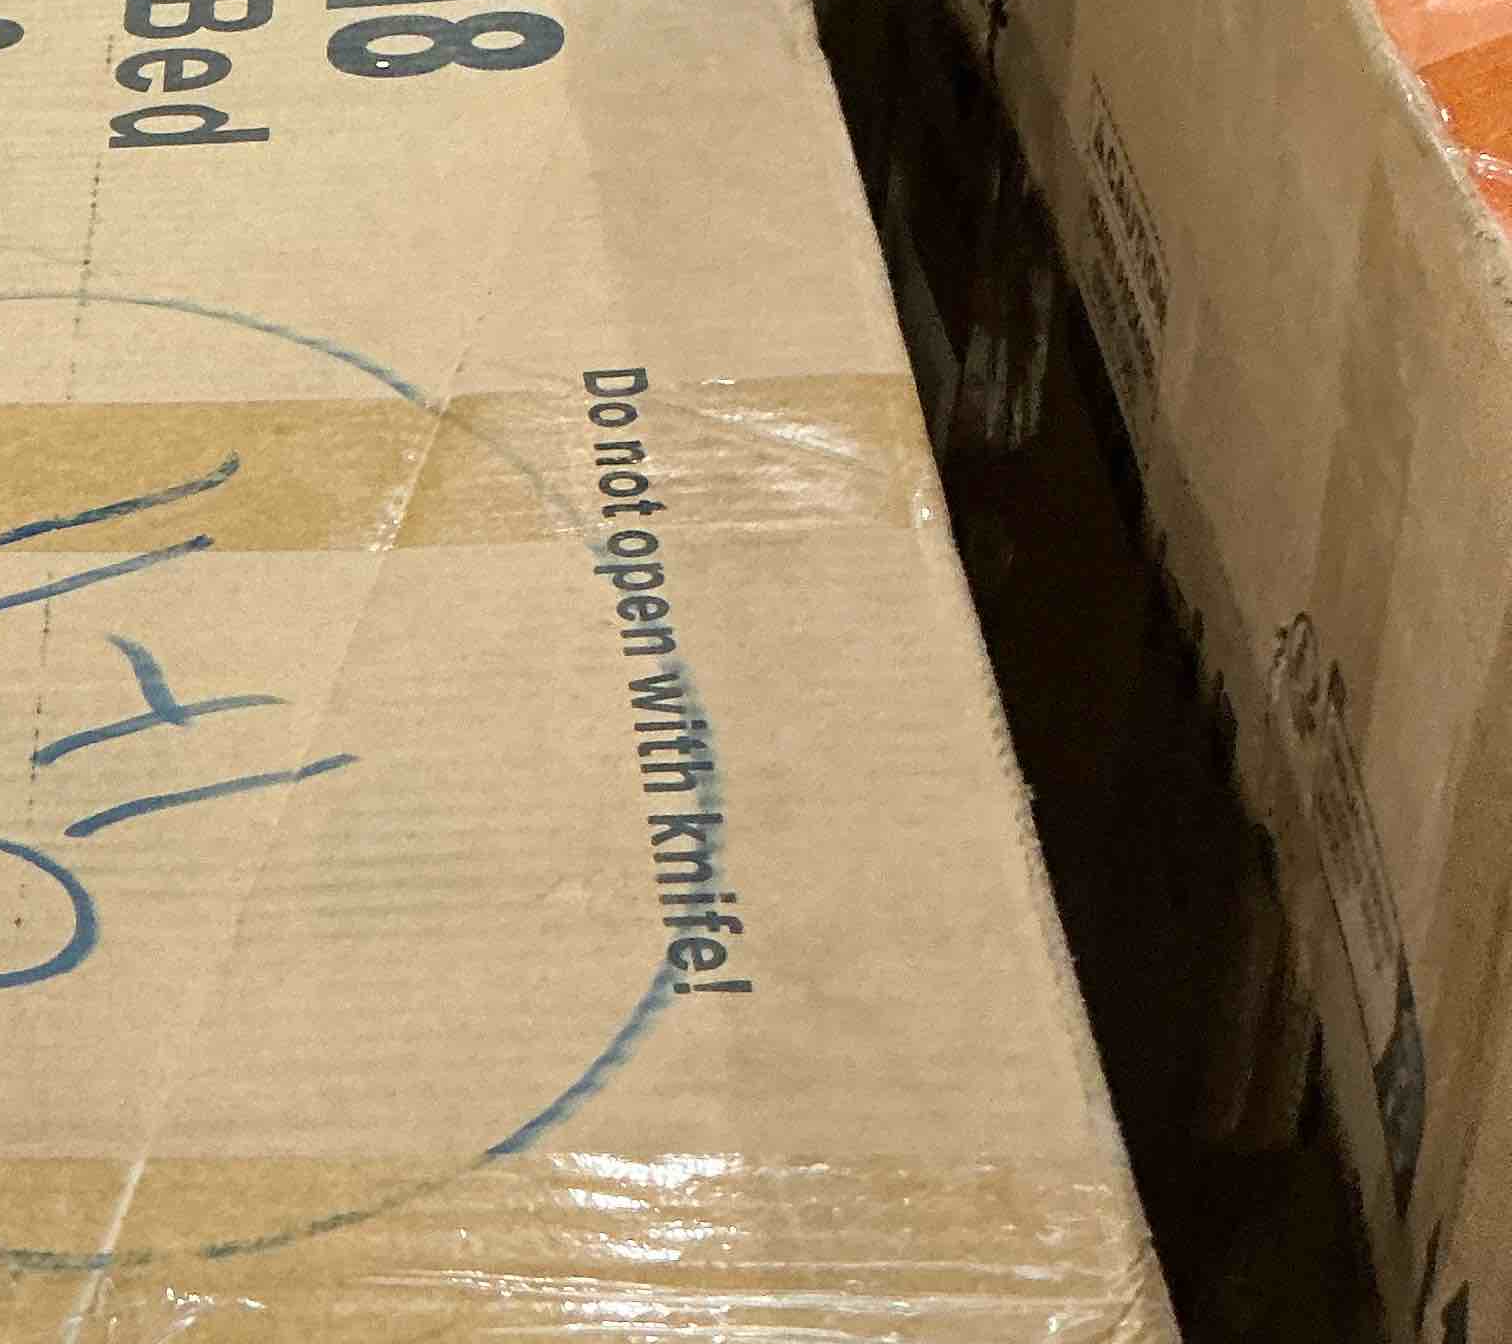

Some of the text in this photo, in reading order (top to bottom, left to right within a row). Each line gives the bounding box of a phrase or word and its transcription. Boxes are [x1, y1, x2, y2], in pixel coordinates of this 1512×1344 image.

[584, 368, 753, 995] Do not open with knife!
